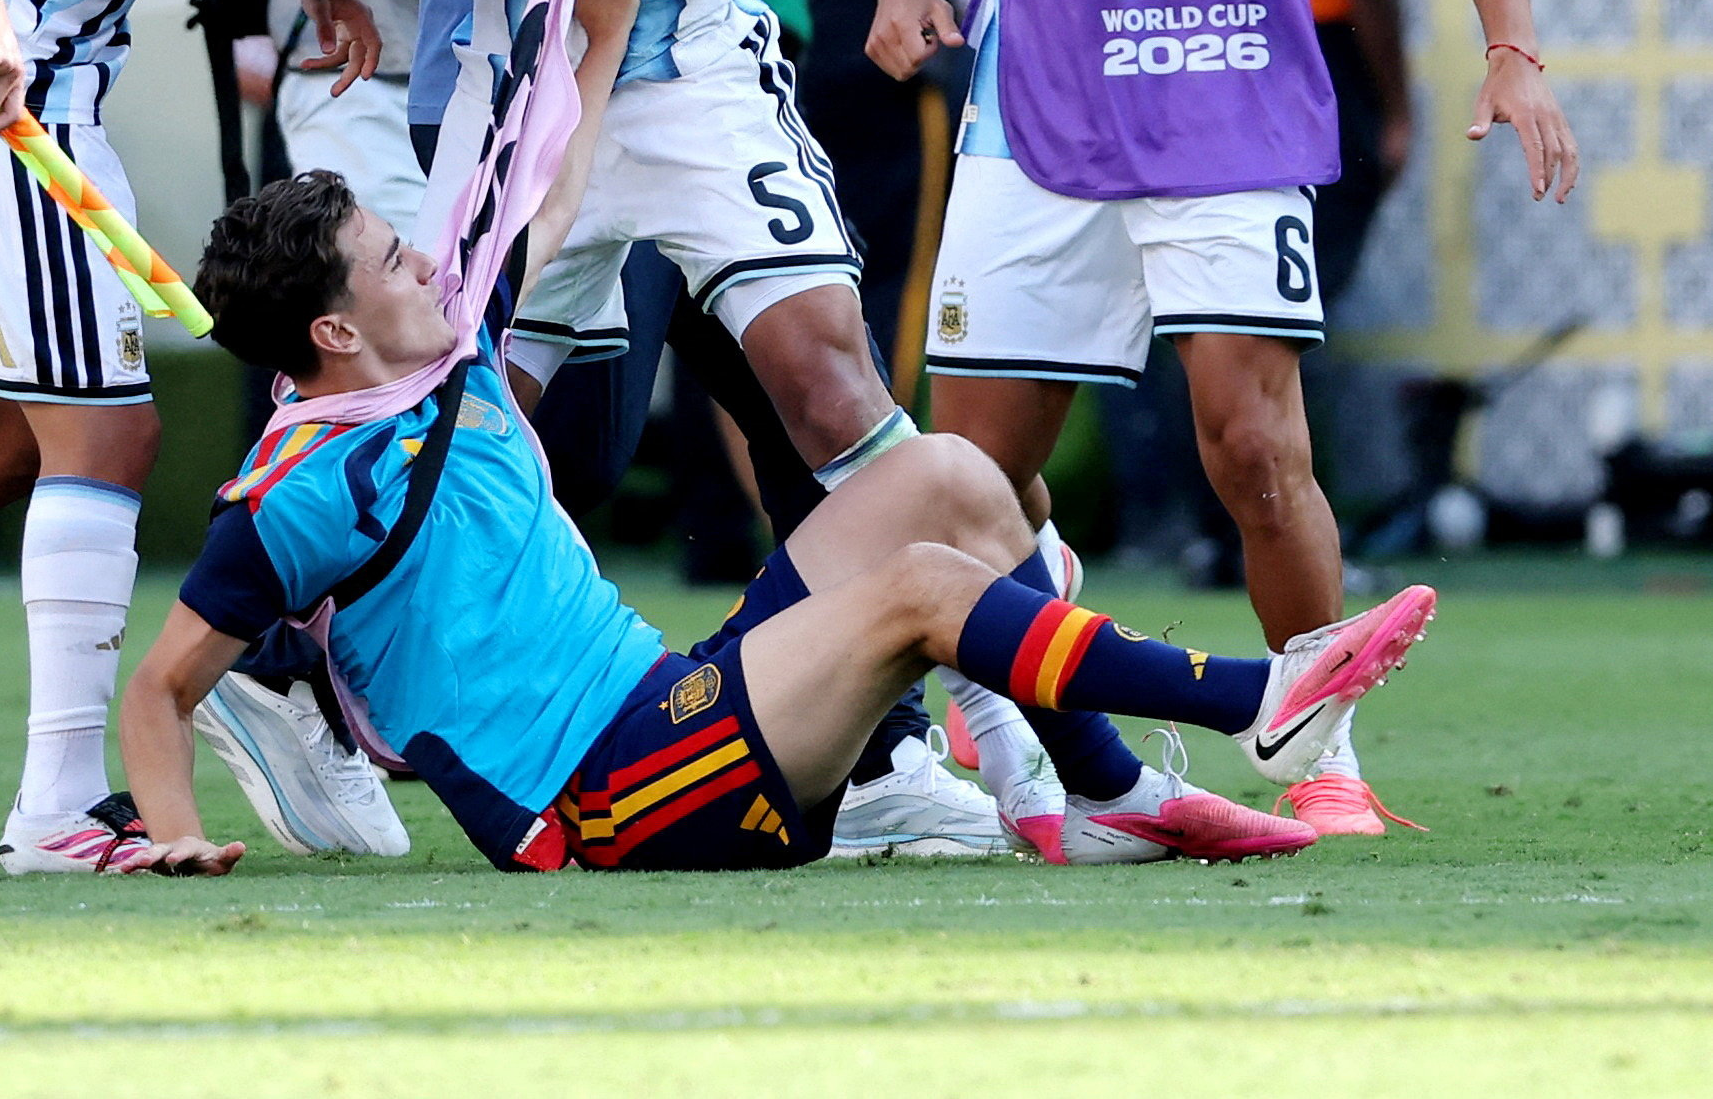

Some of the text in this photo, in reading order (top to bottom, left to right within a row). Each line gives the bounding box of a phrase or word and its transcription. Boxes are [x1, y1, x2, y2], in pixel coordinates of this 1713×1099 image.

[1101, 3, 1268, 33] WORLD CUP
[1102, 32, 1271, 77] 2026
[1274, 214, 1312, 304] 6
